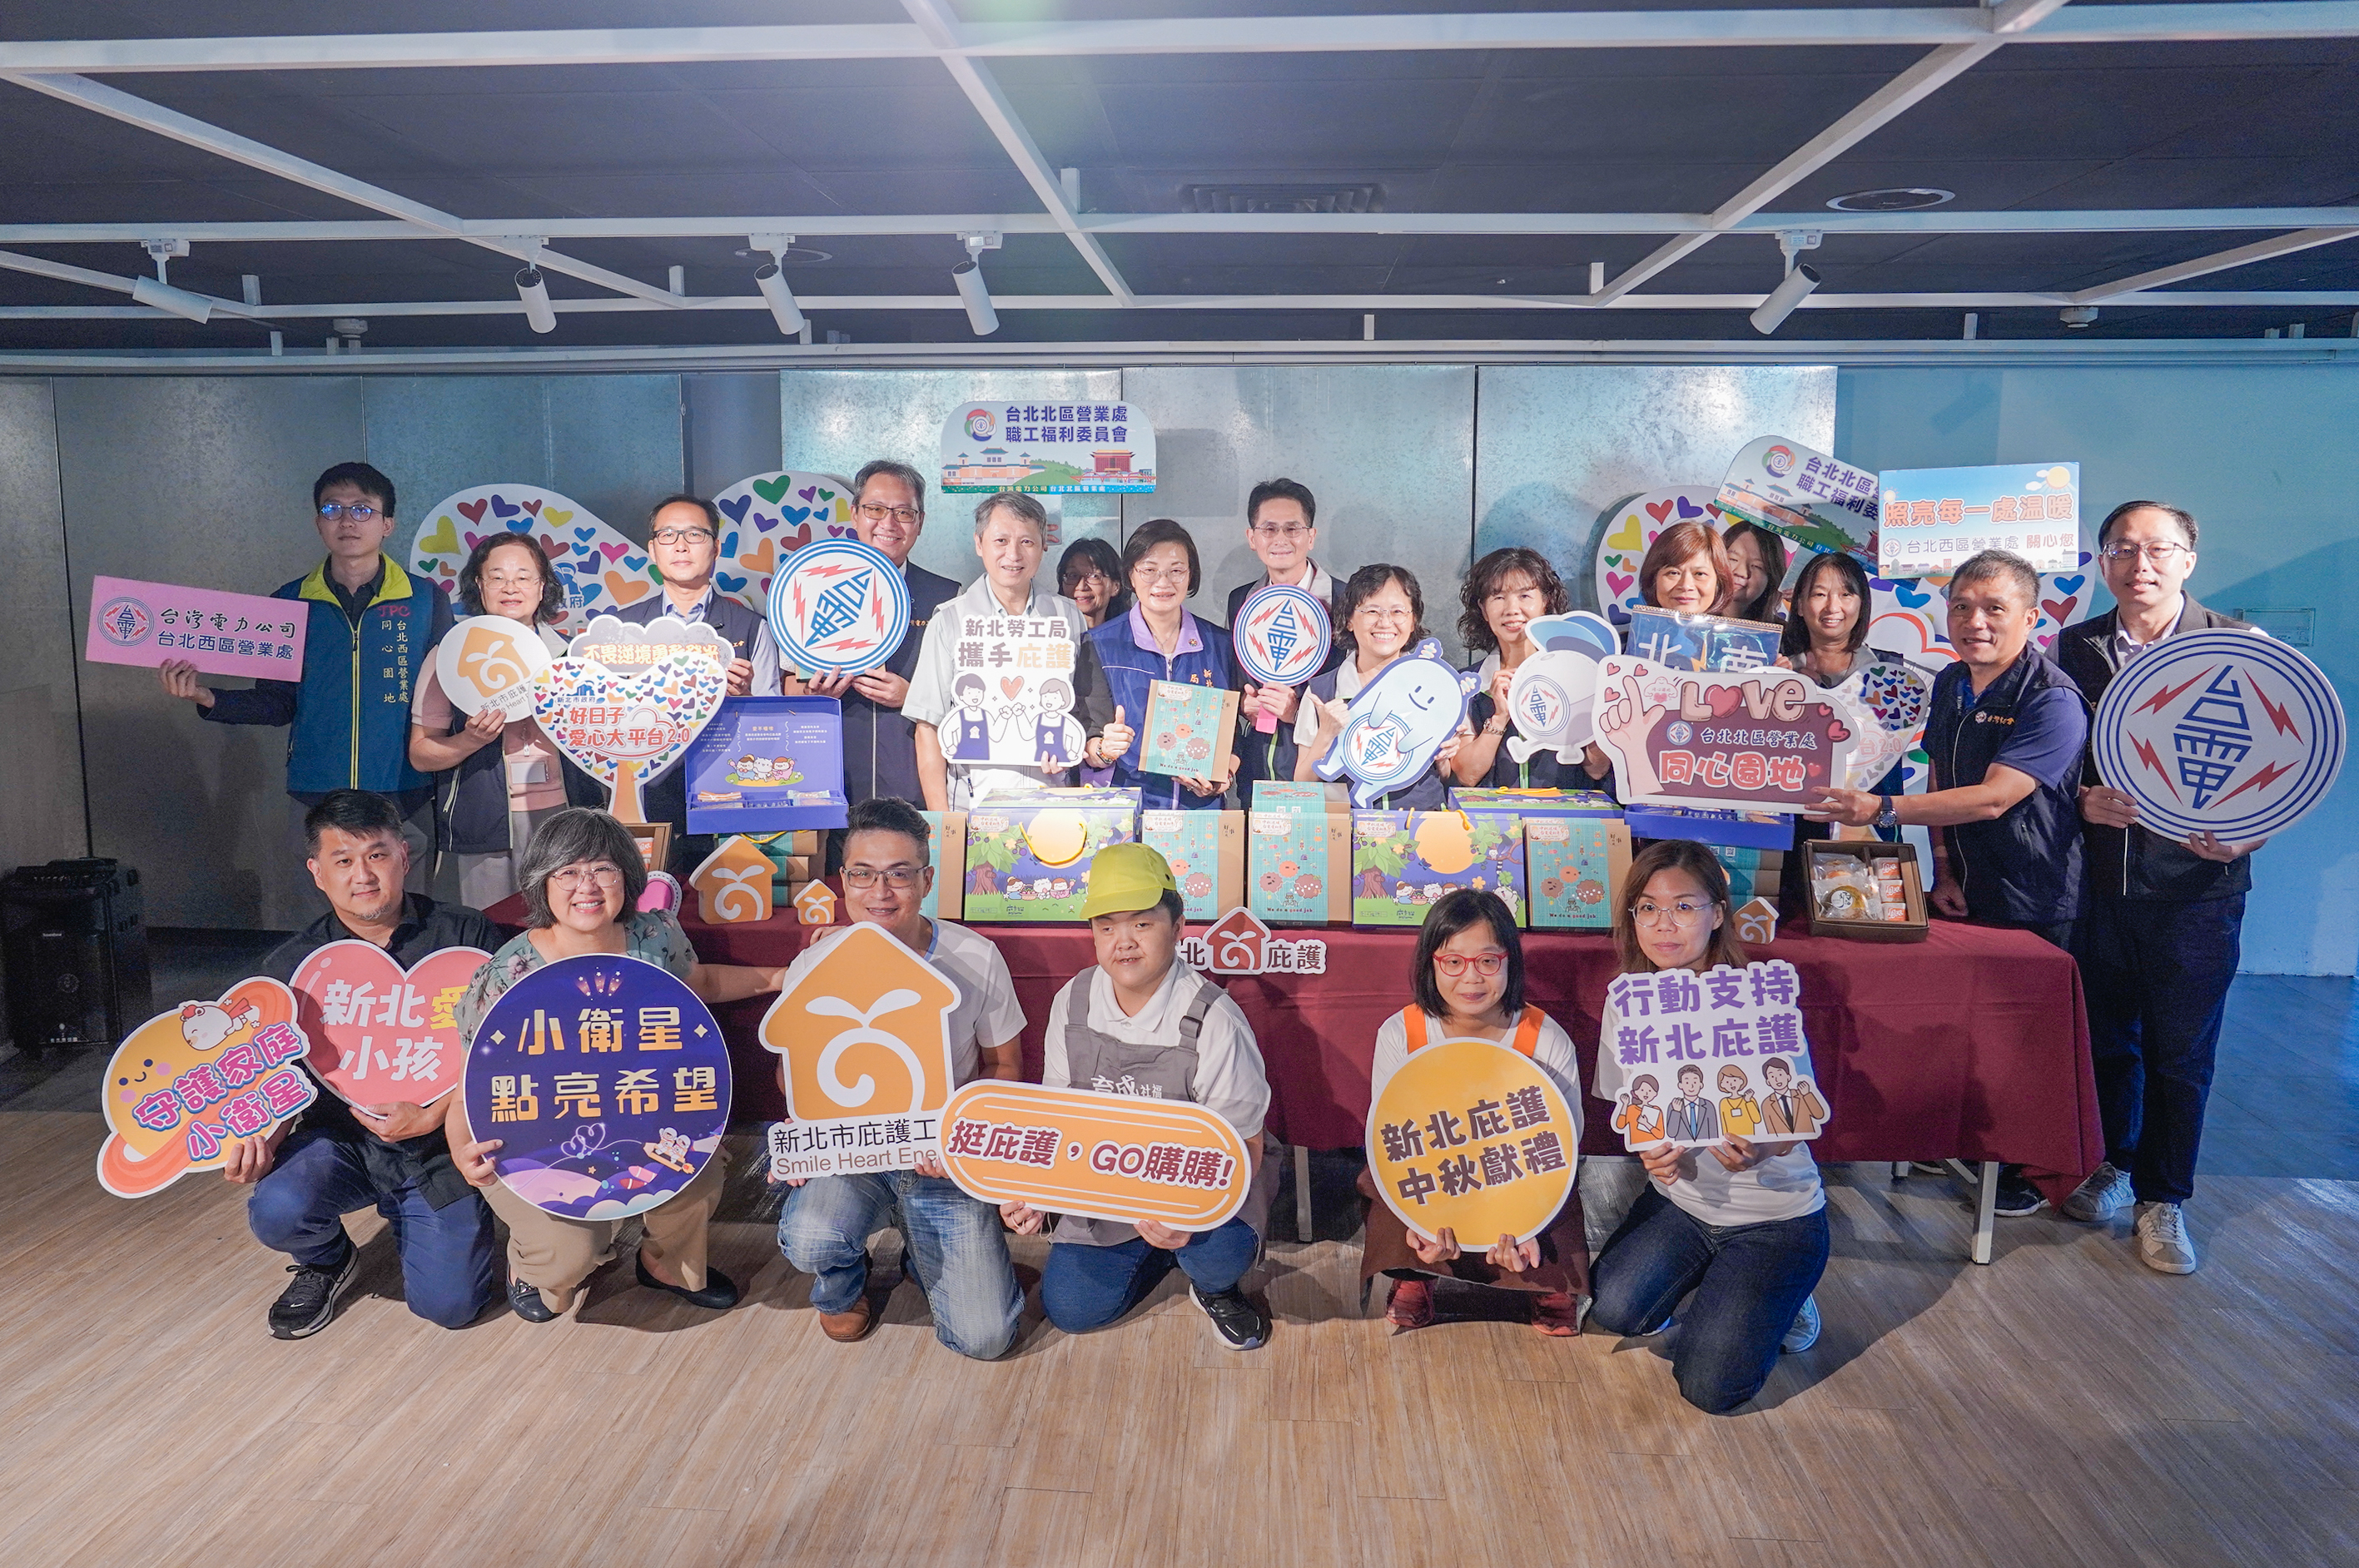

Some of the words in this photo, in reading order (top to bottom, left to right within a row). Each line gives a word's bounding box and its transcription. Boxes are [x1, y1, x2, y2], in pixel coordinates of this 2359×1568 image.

[1006, 405, 1128, 423] 台北北區營業處
[1006, 426, 1128, 444] 職工福利委員會
[1796, 473, 1879, 521] 職工福利委
[1815, 543, 1836, 554] 台北
[1906, 535, 2019, 554] 台北西區營業處
[2026, 533, 2074, 549] 關心您
[156, 631, 294, 661] 台北西區營業處
[965, 618, 1067, 639] 新北勞工局
[381, 620, 396, 704] 同心園地
[395, 620, 410, 703] 台北西區營業處
[958, 641, 1072, 670] 攜手庇護
[569, 707, 625, 725] 好日子
[568, 727, 664, 747] 愛心大平台
[668, 727, 691, 743] 2.0
[1700, 727, 1818, 749] 台北北區營業處
[1880, 737, 1903, 754] 2.0
[1659, 751, 1806, 791] 同心園地
[1180, 941, 1205, 966] 北
[1267, 944, 1322, 970] 庇護
[1612, 965, 1795, 1018] 行動支持
[517, 1005, 683, 1055] 小衛星
[1617, 1012, 1800, 1065] 新北庇護
[132, 1022, 307, 1130] 守護家庭
[339, 1035, 444, 1082] 小孩
[490, 1065, 718, 1123] 點亮希望
[186, 1070, 315, 1161] 小衛星
[1379, 1084, 1551, 1164] 新北庇護
[773, 1118, 936, 1155] 新北市庇護工
[776, 1153, 832, 1175] Smile
[837, 1149, 892, 1170] Heart
[1397, 1129, 1567, 1206] 中秋獻禮
